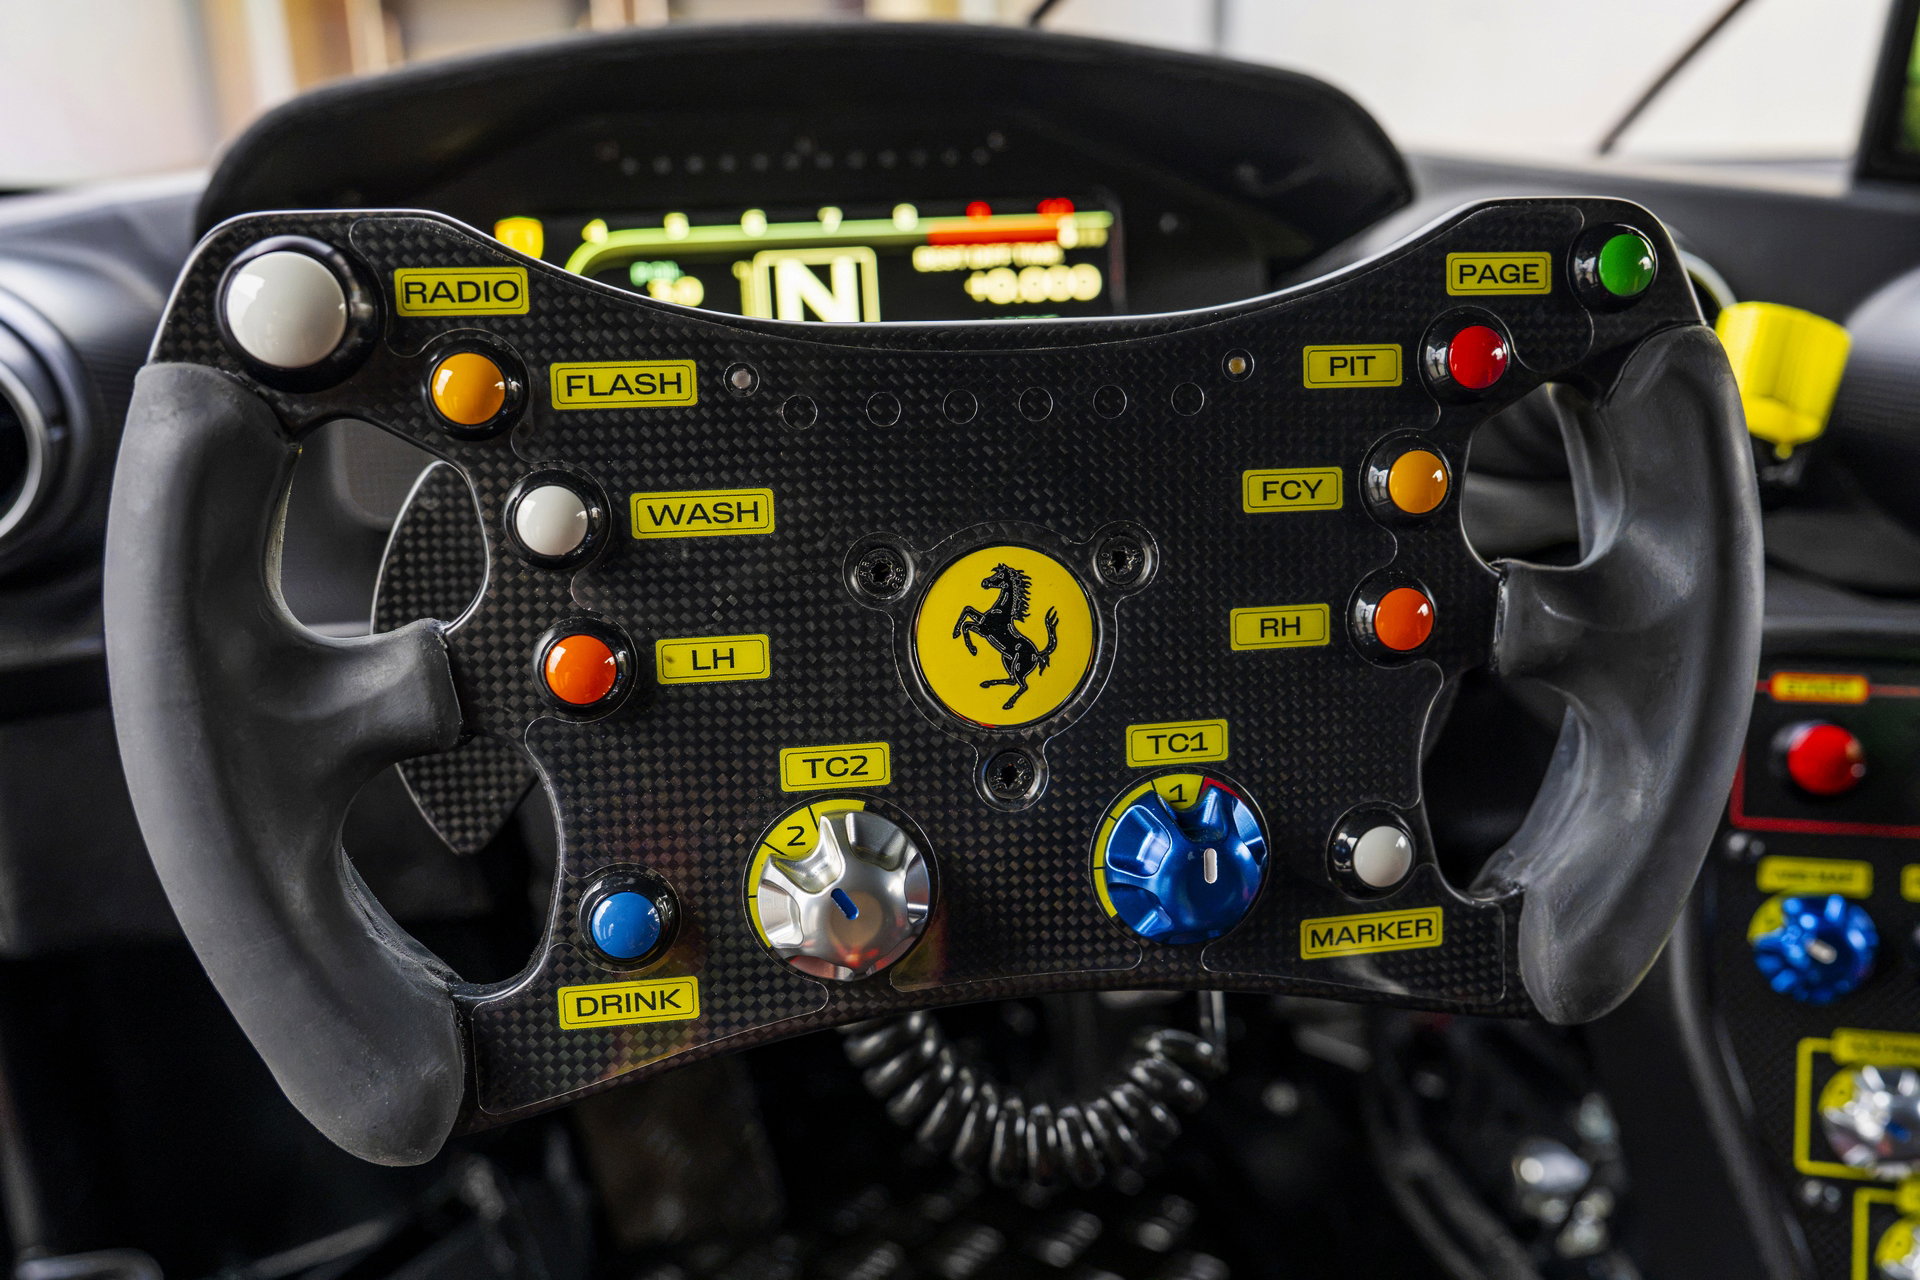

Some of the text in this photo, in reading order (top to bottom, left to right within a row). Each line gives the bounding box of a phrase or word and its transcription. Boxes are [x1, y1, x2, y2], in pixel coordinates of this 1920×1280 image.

[1460, 264, 1539, 284] PAGE
[405, 280, 518, 303] RADIO
[775, 256, 859, 322] N
[1330, 356, 1376, 376] PIT
[567, 373, 681, 396] FLASH
[1263, 479, 1323, 500] FCY
[647, 502, 758, 526] WASH
[1261, 616, 1300, 638] RH
[692, 648, 734, 670] LH
[1147, 732, 1208, 754] TC1
[803, 756, 868, 778] TC2
[1169, 784, 1188, 802] 1
[787, 826, 805, 846] 2
[1311, 919, 1432, 948] MARKER
[577, 989, 680, 1017] DRINK
